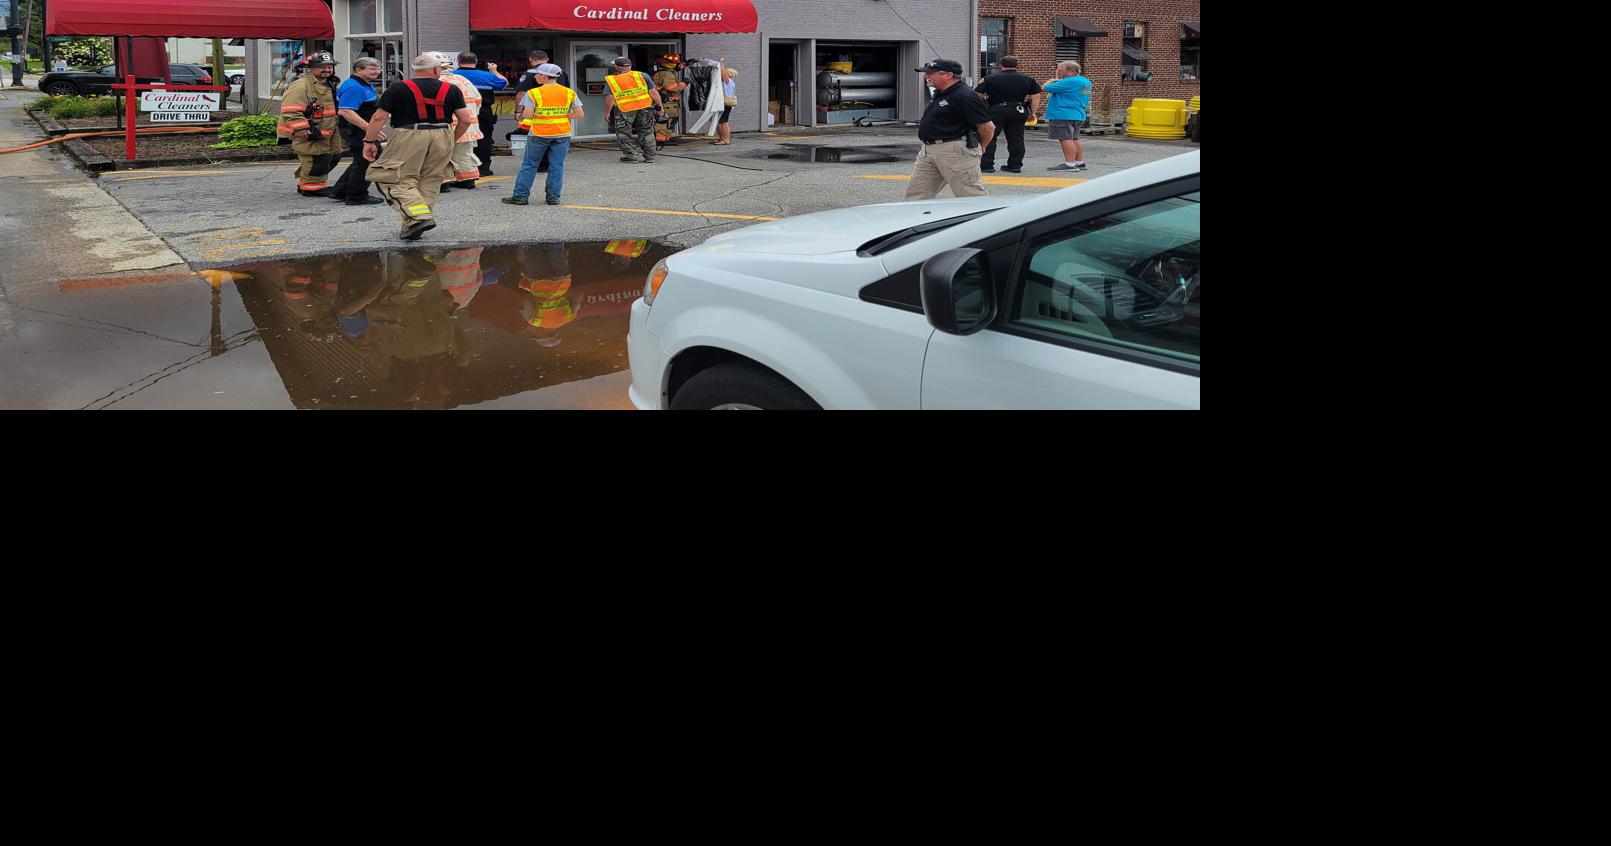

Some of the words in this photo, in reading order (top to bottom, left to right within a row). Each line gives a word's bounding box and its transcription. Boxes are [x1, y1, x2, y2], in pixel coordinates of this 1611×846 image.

[573, 5, 648, 20] Cardinal
[655, 8, 723, 21] Cleaners
[144, 93, 200, 102] Cardinal
[158, 101, 211, 110] Cleaners
[153, 112, 180, 120] DRIVE
[184, 112, 208, 120] THRU
